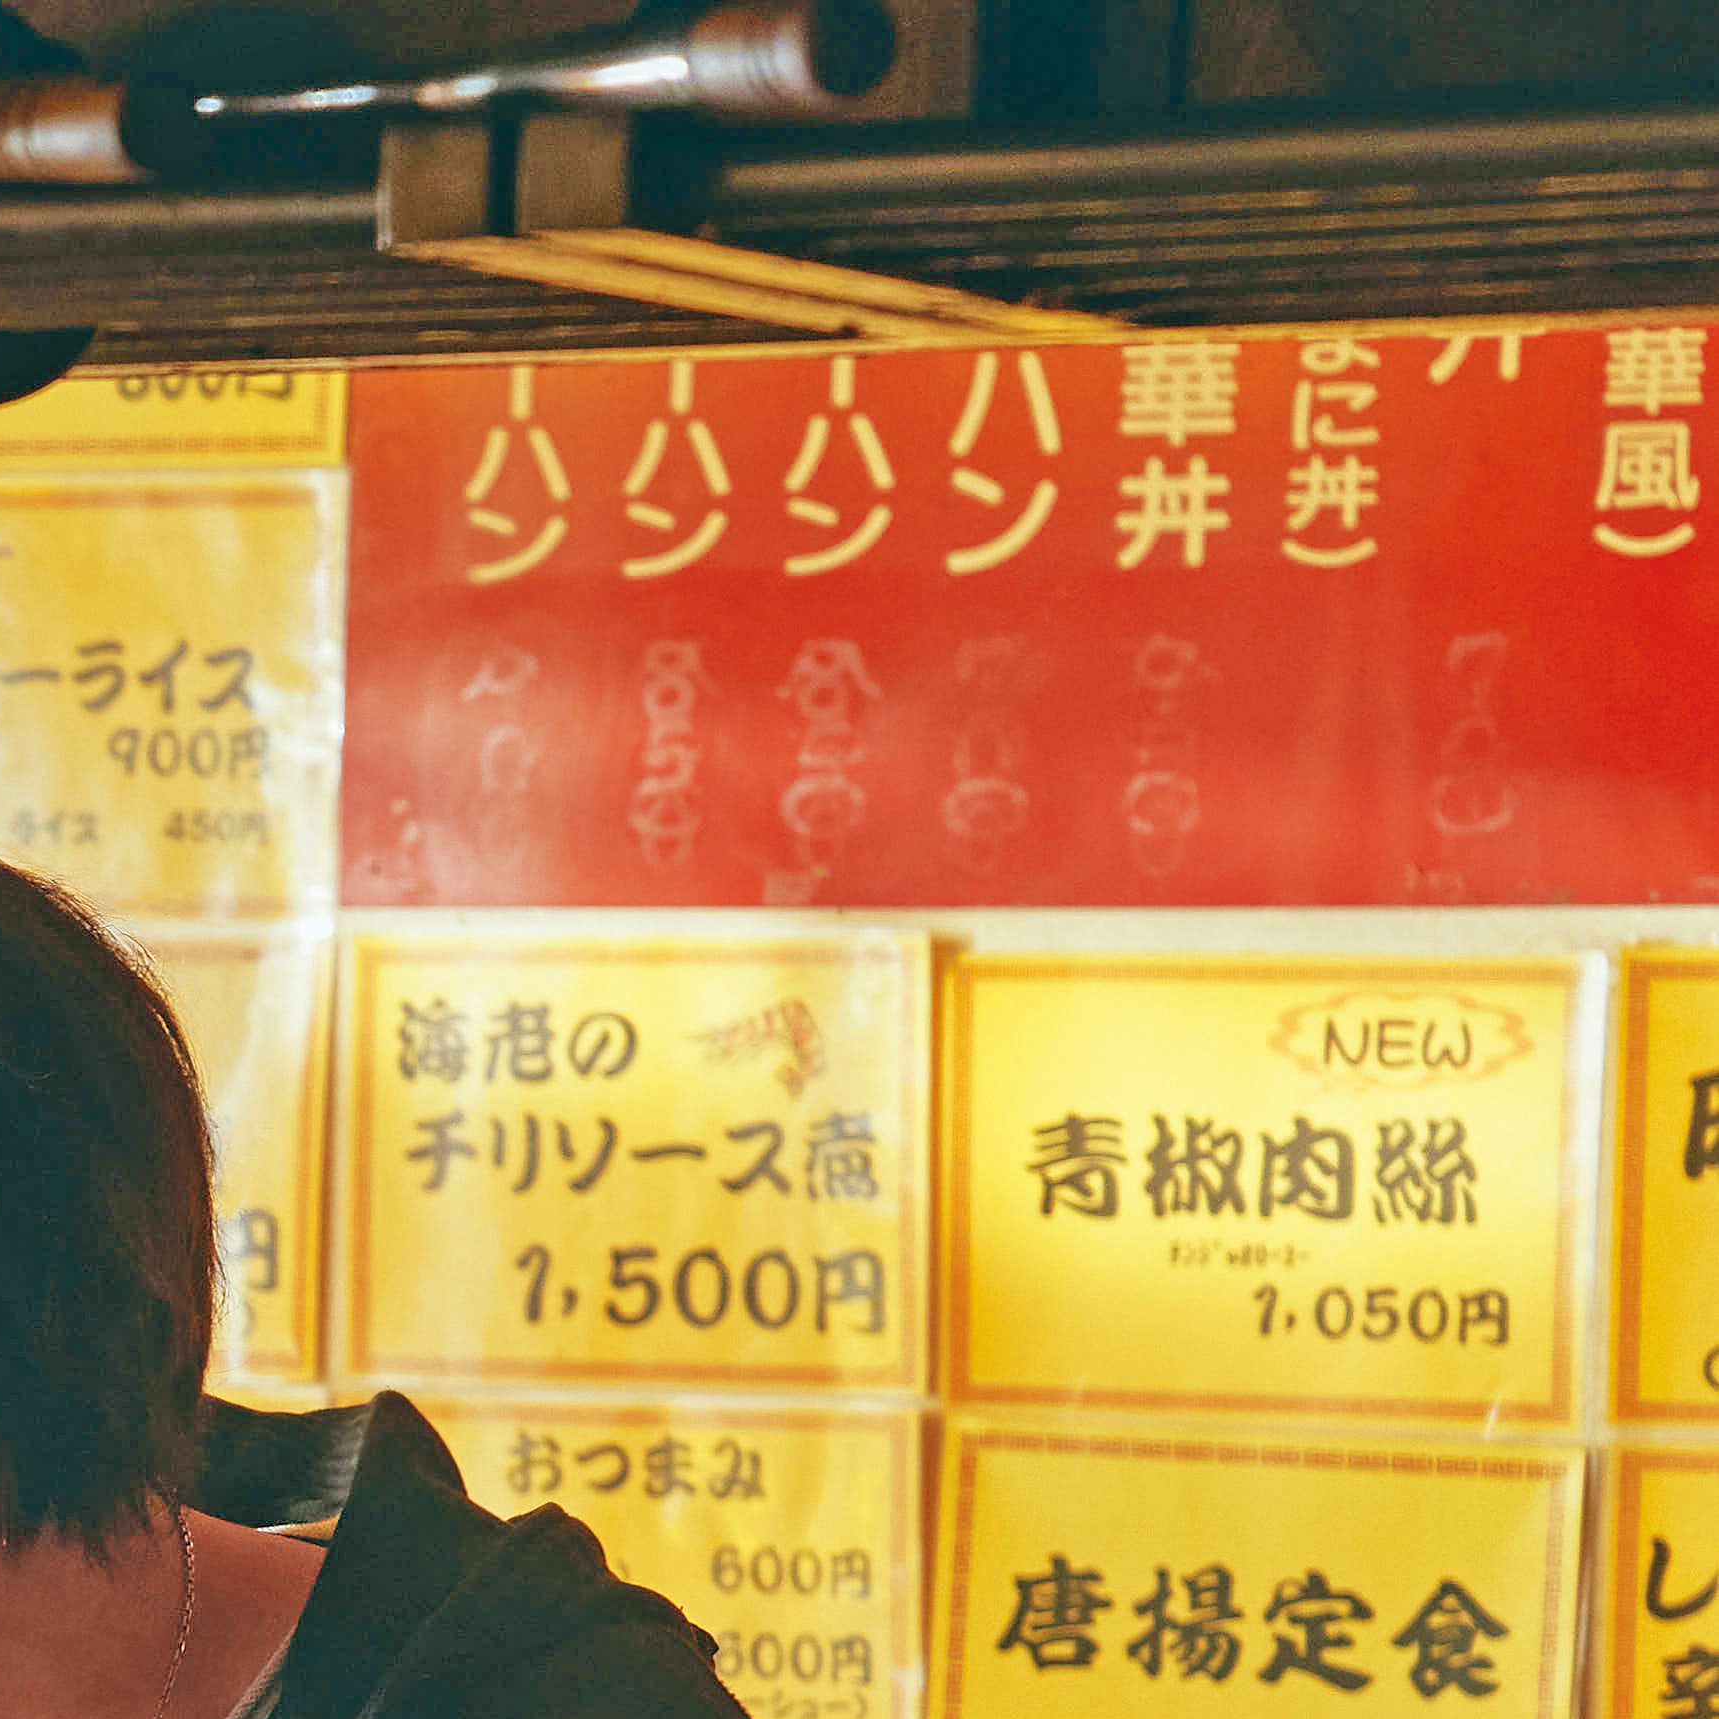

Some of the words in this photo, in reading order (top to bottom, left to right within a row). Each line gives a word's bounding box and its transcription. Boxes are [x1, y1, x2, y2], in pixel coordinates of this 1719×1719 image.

[107, 726, 272, 780] 900円
[1322, 1017, 1473, 1069] NEW
[1027, 1111, 1480, 1226] 青椒肉絲
[515, 1242, 887, 1334] 1,500円
[1252, 1283, 1511, 1347] 1,050円
[505, 1429, 767, 1500] おつまみ
[709, 1543, 874, 1600] 600円
[716, 1630, 874, 1687] 600円
[996, 1554, 1512, 1701] 唐揚定食
